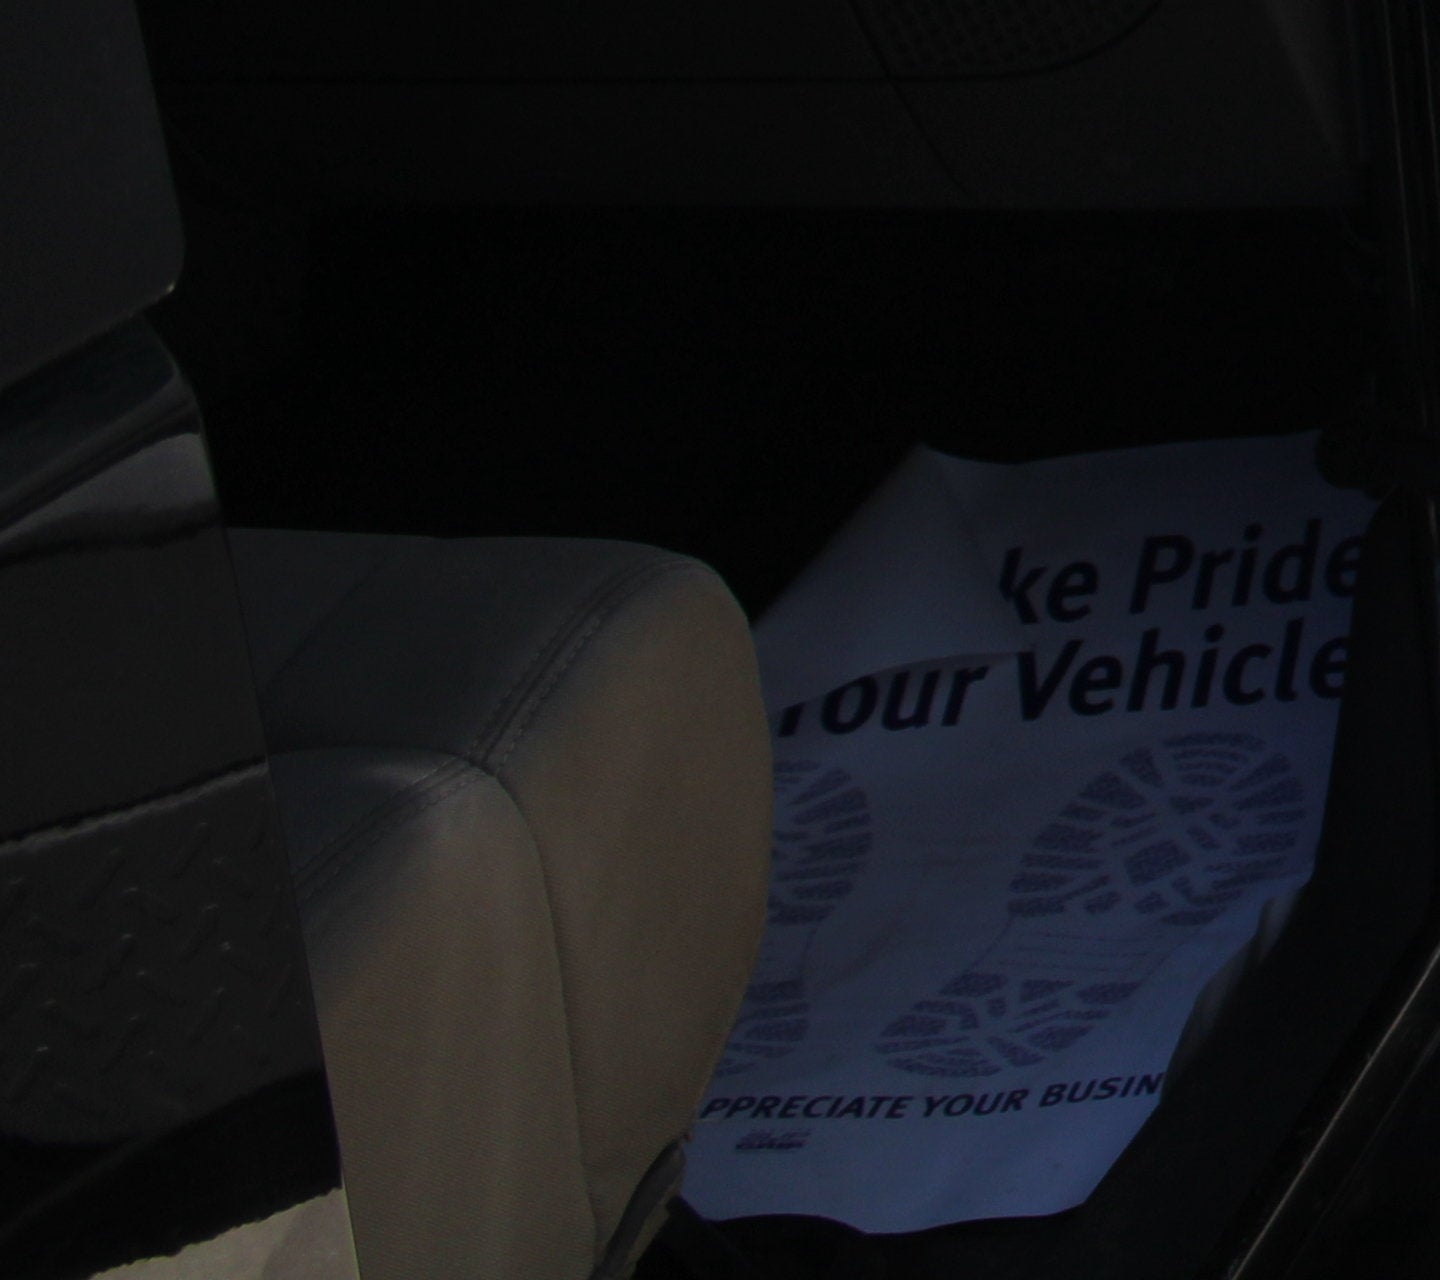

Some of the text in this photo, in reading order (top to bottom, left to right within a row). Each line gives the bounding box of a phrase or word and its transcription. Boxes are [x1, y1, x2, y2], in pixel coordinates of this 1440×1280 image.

[1128, 518, 1368, 616] Pride
[1016, 618, 1354, 722] Vehicle
[699, 1072, 1164, 1121] PPRECIATE YOUR BUSIN
